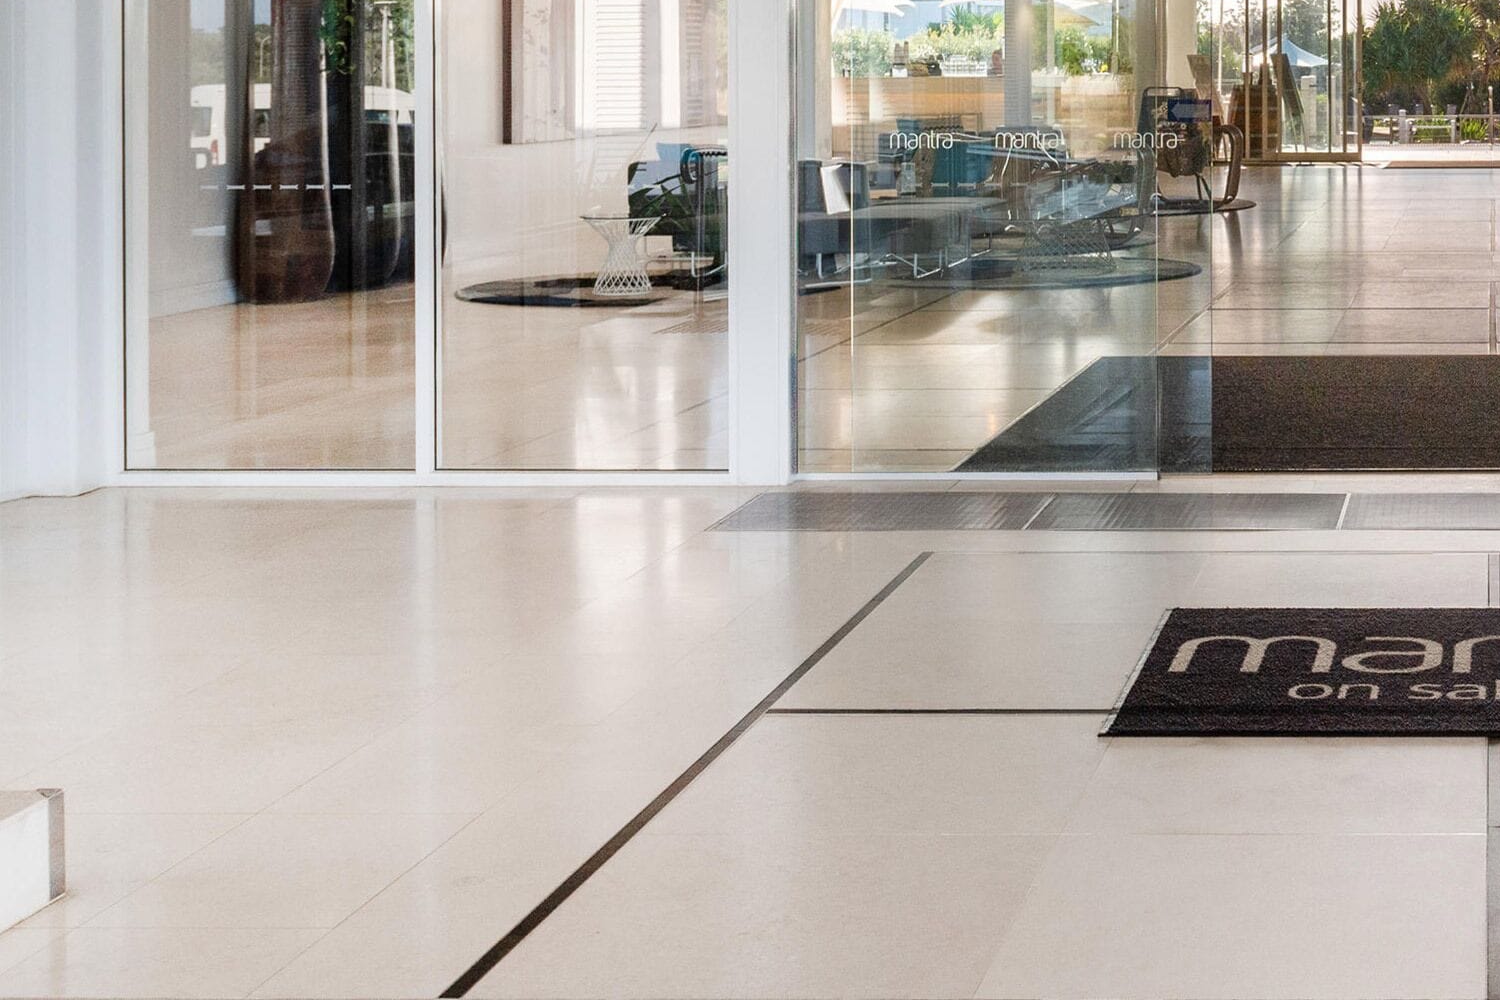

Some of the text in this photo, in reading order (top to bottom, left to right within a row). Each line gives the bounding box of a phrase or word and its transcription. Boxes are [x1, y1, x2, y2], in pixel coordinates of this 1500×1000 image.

[889, 129, 960, 150] mantra
[994, 129, 1061, 149] mantra
[1113, 130, 1186, 149] mantra
[1288, 683, 1380, 700] on
